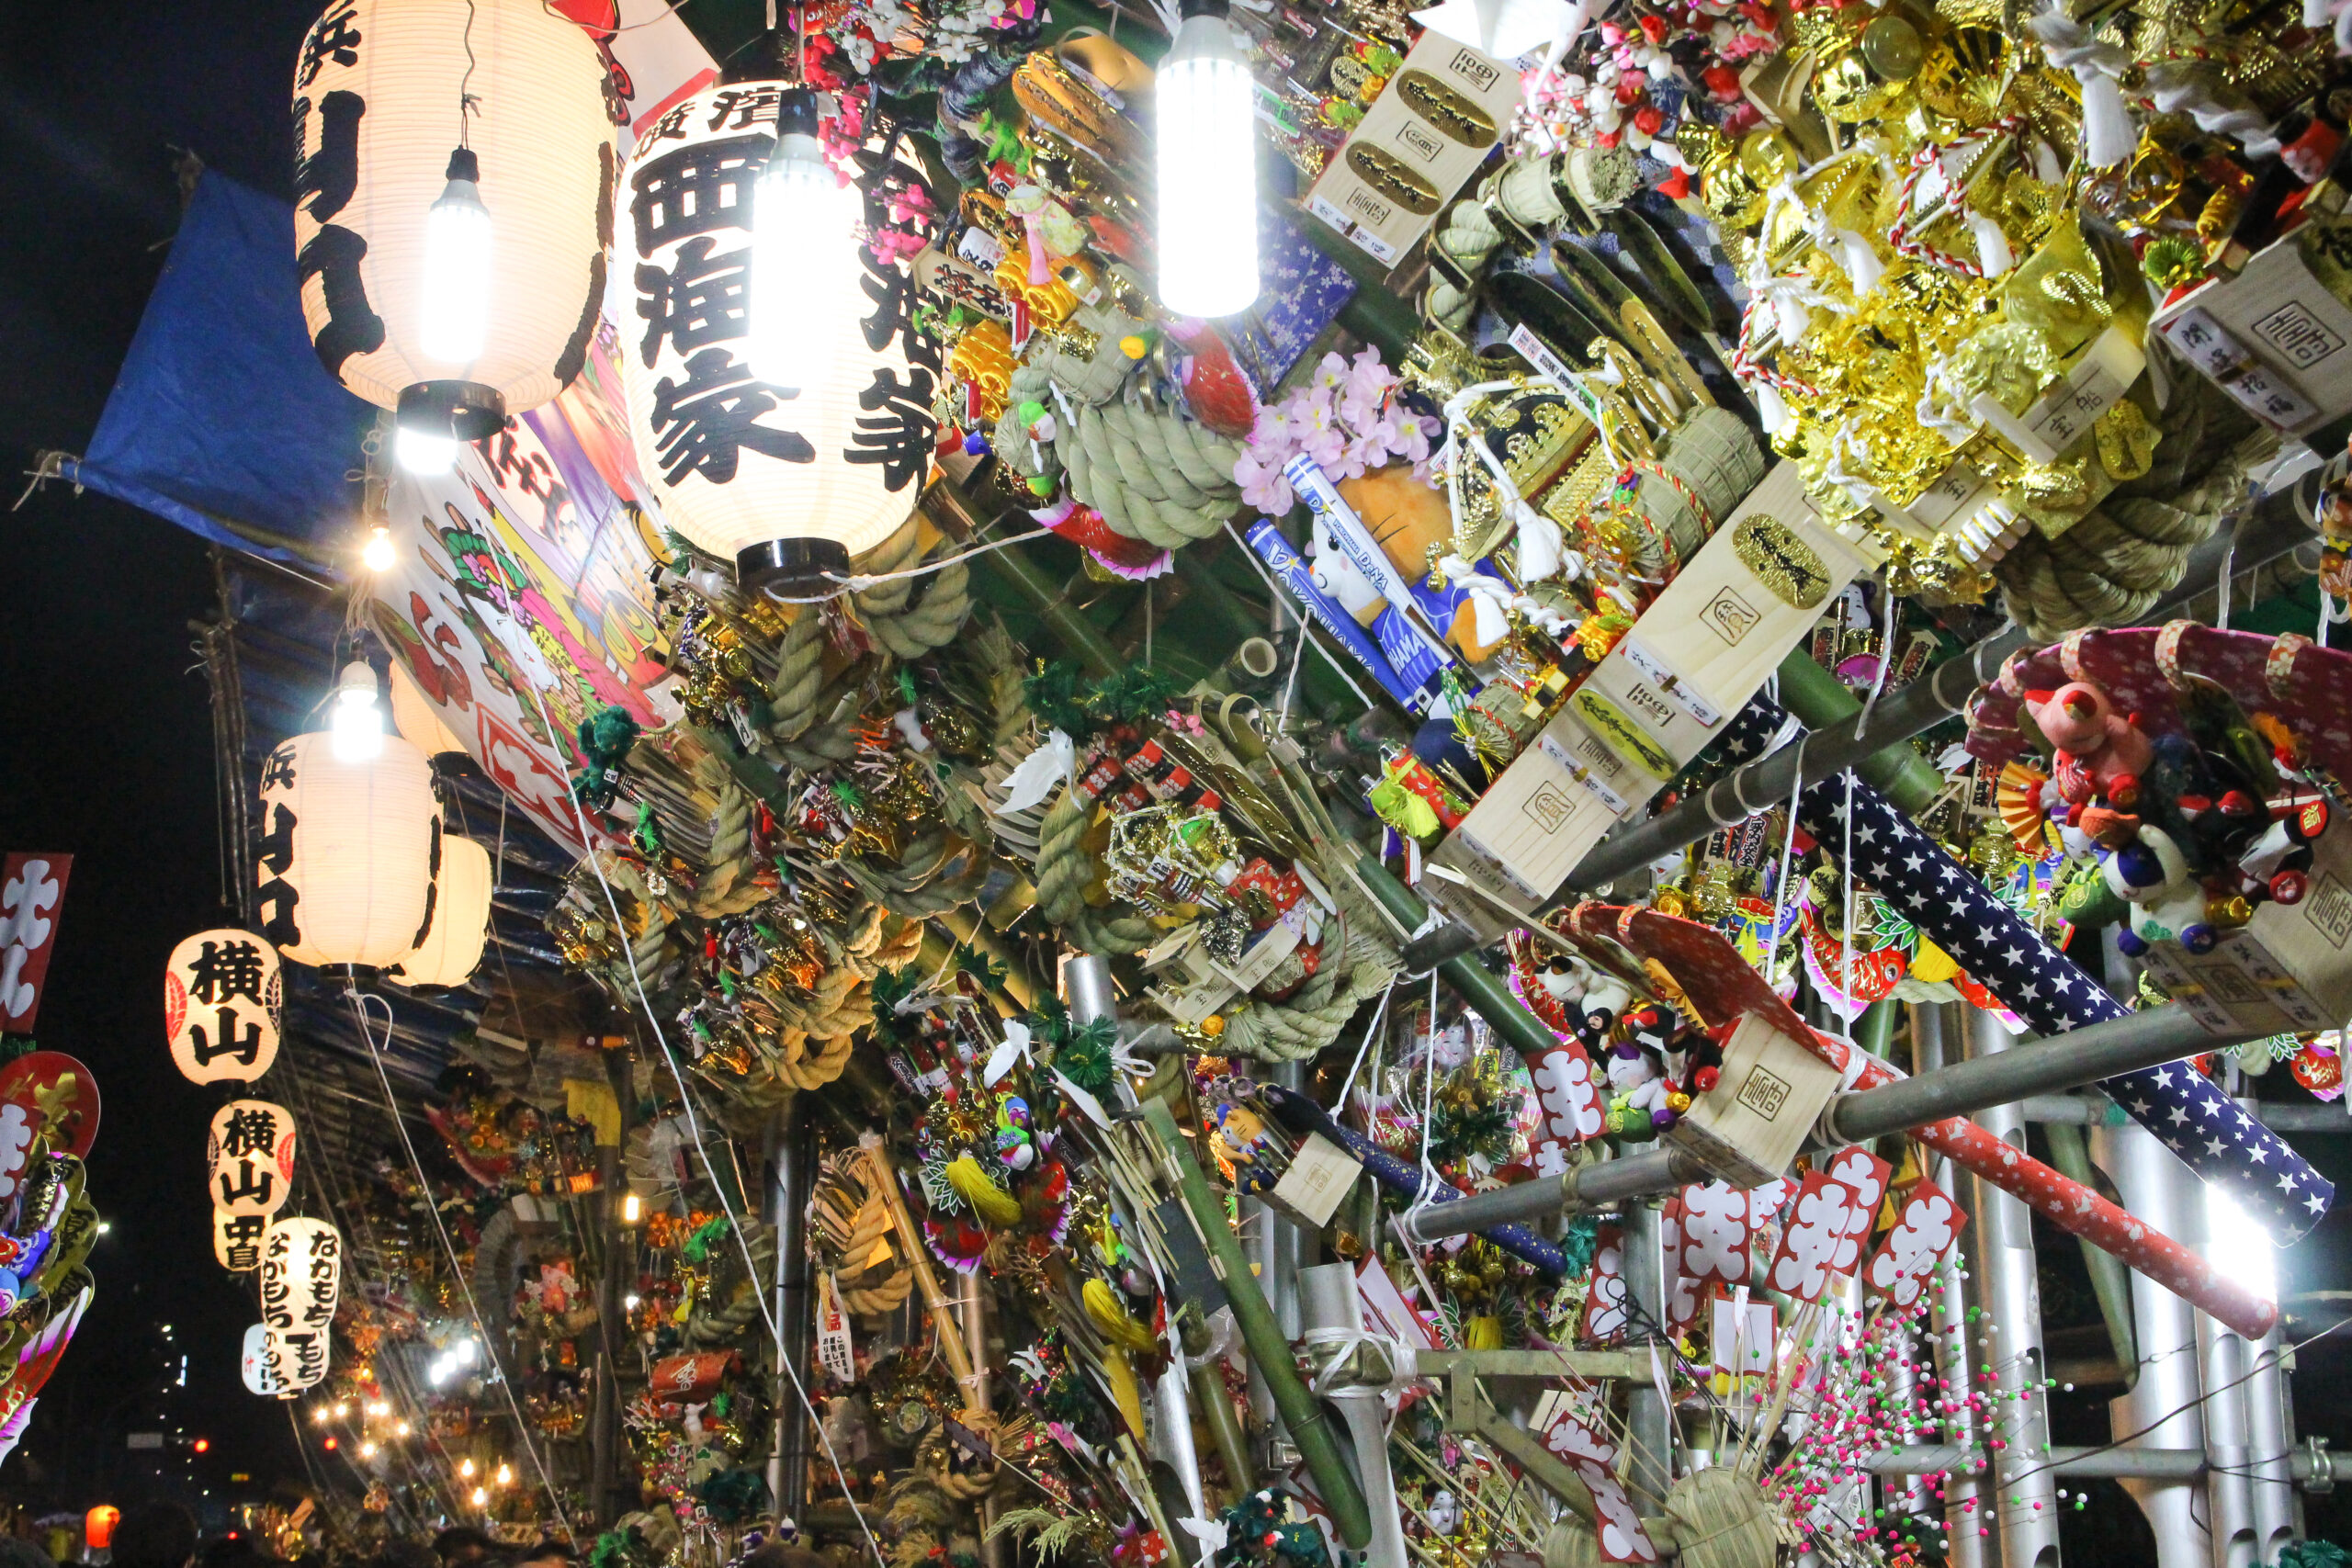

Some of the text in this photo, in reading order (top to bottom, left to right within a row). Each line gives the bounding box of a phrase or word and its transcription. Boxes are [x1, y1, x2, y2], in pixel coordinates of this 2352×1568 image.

[1333, 517, 1361, 555] YOKOHAMA
[1358, 552, 1390, 592] DeNA
[188, 940, 264, 1066] 横山
[220, 1108, 277, 1206] 横山
[303, 1230, 338, 1328] なかもち
